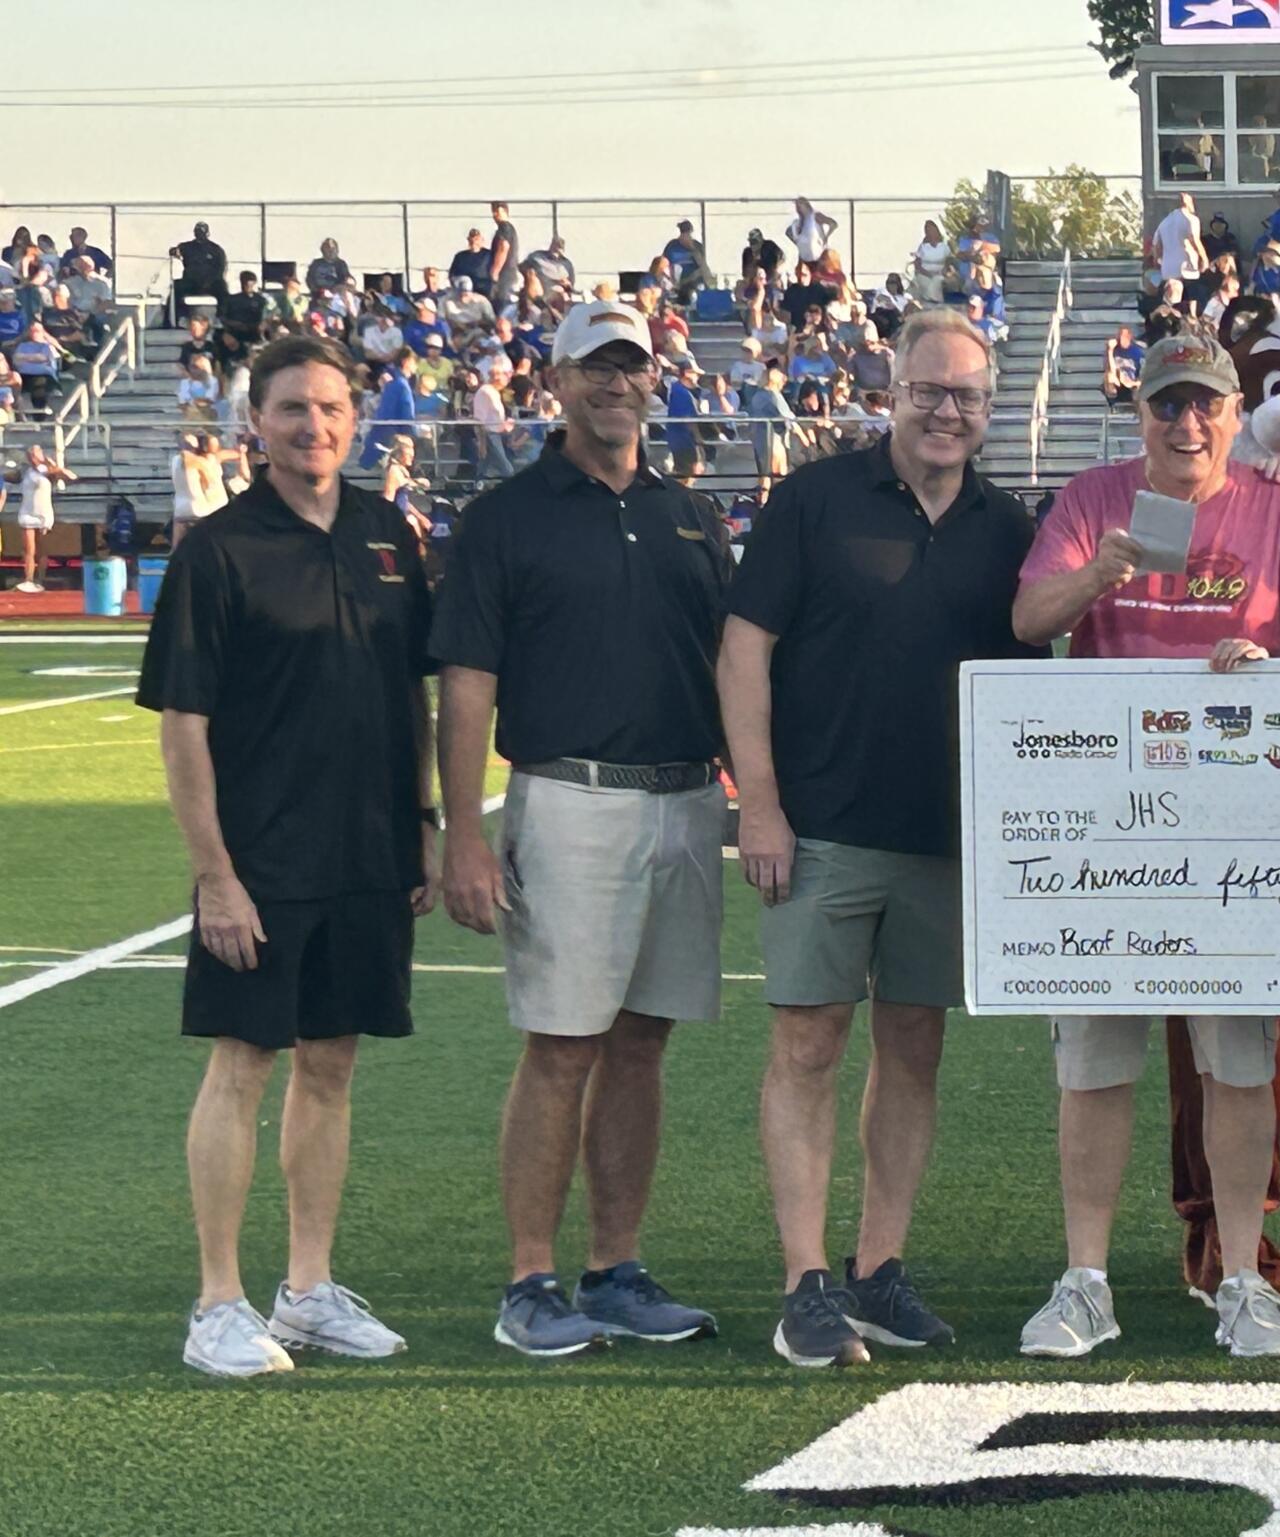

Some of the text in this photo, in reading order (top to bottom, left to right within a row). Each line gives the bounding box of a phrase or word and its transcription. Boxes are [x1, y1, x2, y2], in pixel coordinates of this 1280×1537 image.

[1012, 715, 1119, 749] Jonesboro
[1002, 811, 1098, 825] PAY TO THE
[1115, 791, 1181, 831] JHS
[1002, 828, 1088, 842] ORDER OF
[1008, 855, 1064, 895] Two
[1071, 857, 1199, 891] hundred
[1002, 942, 1055, 956] MEMO
